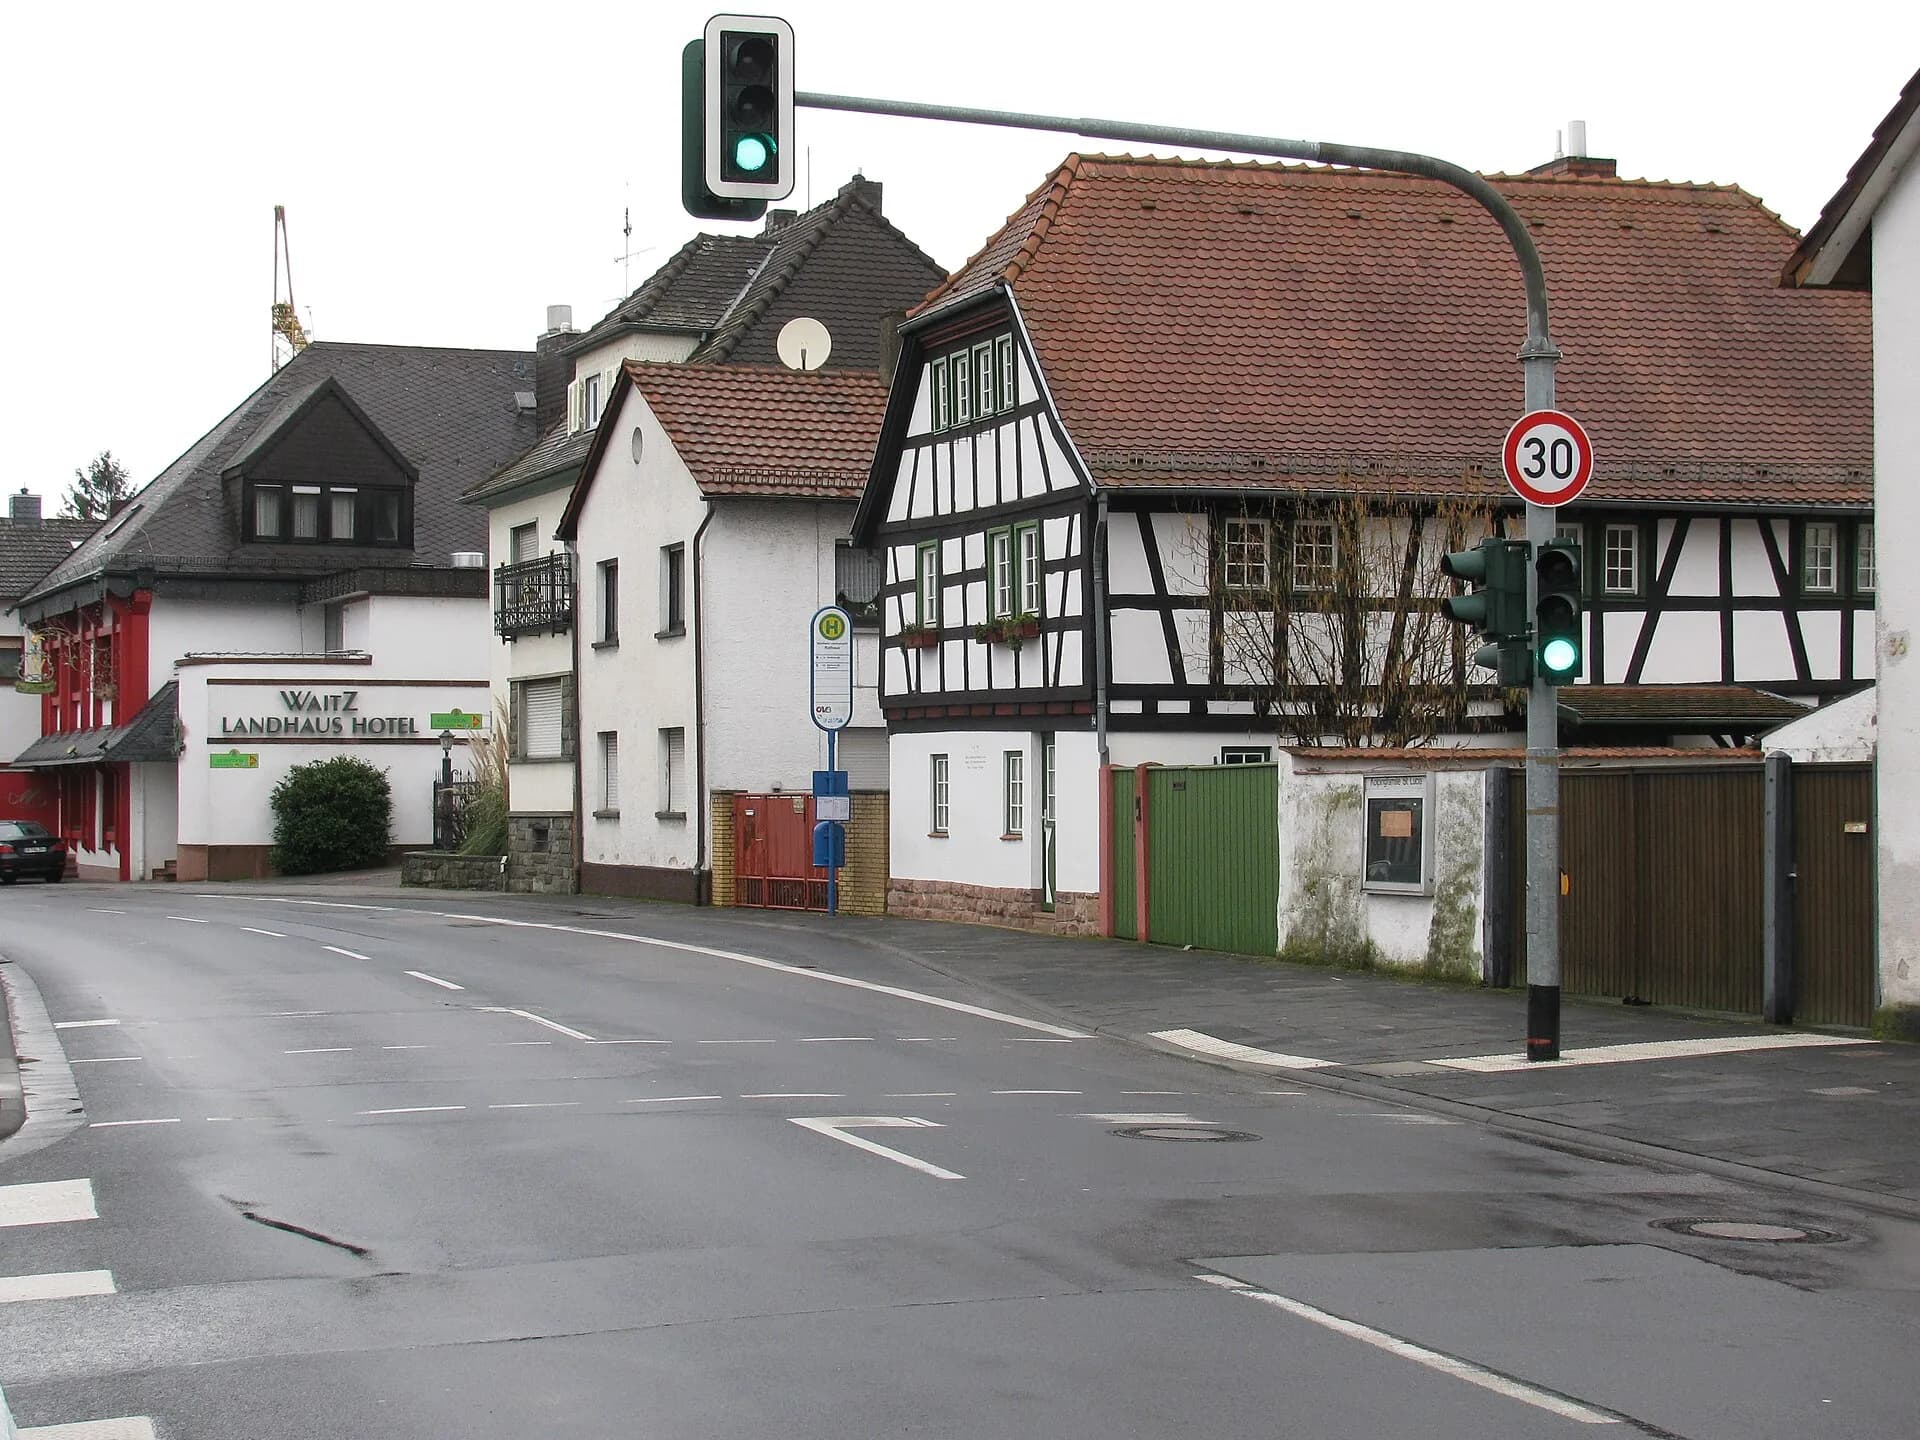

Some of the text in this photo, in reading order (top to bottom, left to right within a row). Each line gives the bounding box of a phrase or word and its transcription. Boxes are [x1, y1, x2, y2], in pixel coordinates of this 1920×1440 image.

[1523, 437, 1573, 479] 30
[222, 716, 344, 734] LANDHAUS
[351, 716, 420, 734] HOTEL
